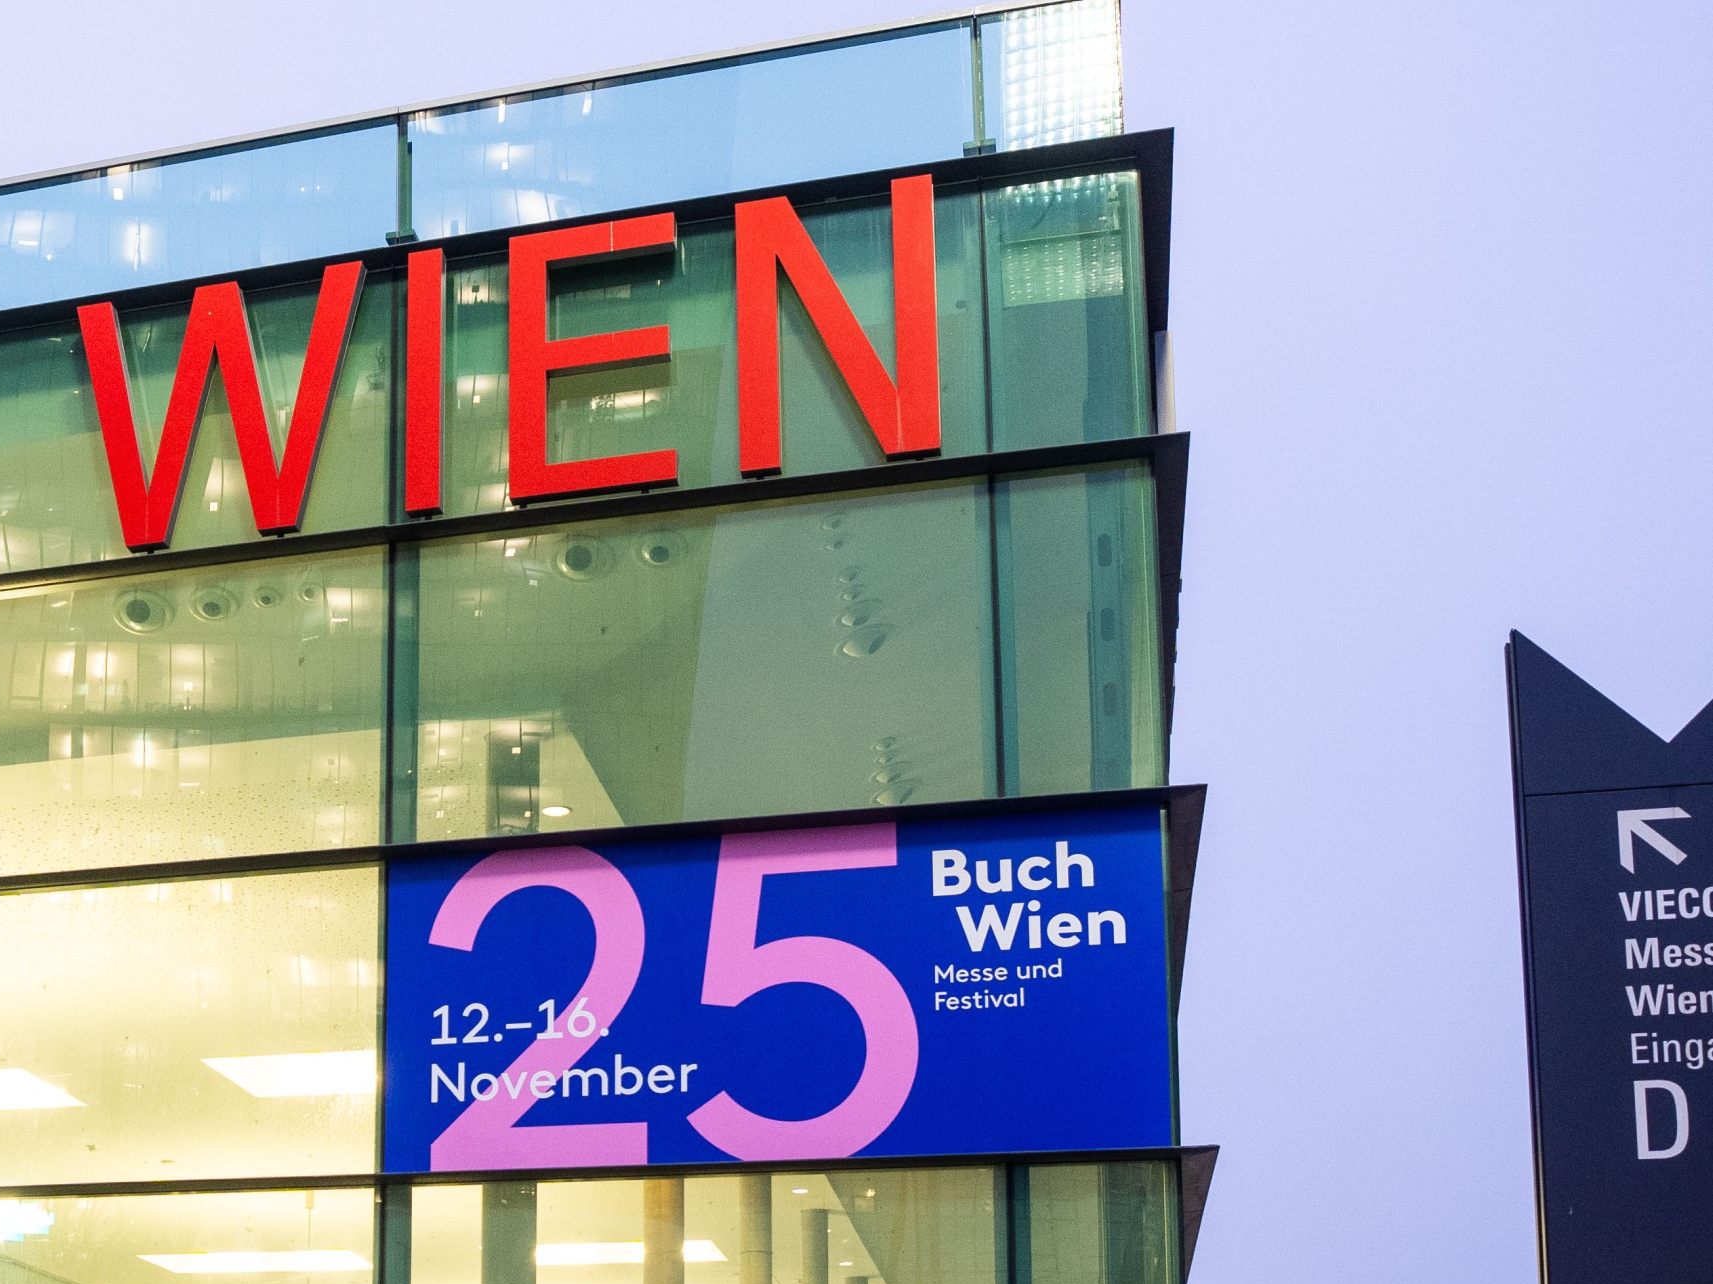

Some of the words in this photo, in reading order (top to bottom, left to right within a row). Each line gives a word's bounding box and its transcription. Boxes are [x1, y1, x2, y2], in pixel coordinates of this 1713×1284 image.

[77, 173, 943, 552] WIEN
[931, 841, 1095, 897] Buch
[955, 901, 1127, 953] Wien
[428, 821, 919, 1173] 25
[934, 963, 1008, 985] Messe
[1015, 958, 1063, 981] und
[934, 987, 1025, 1011] Festival
[430, 1054, 697, 1104] November
[1633, 1079, 1690, 1160] D
